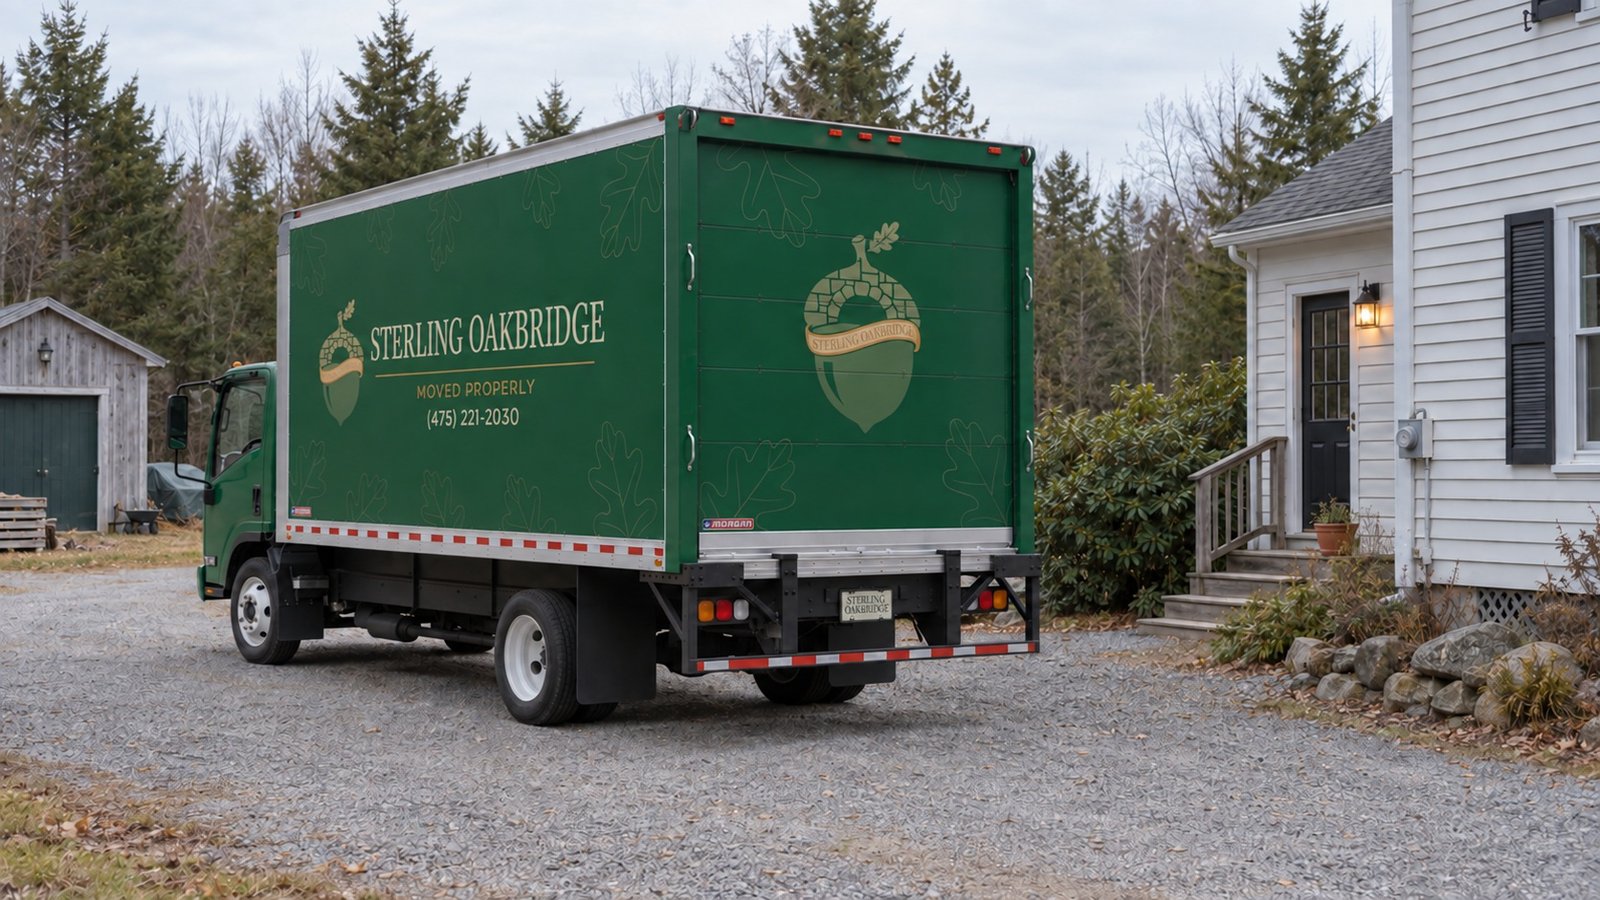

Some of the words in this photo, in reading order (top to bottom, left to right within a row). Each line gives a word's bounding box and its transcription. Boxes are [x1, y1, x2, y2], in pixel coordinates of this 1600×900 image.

[370, 316, 463, 361] STERLING
[469, 300, 605, 353] OAKBRIDGE
[812, 333, 859, 351] STERLING
[416, 382, 461, 399] MOVED
[465, 379, 535, 397] PROPERLY
[427, 409, 457, 430] (475)
[460, 407, 519, 426] 221-2030
[846, 594, 885, 605] STERLING
